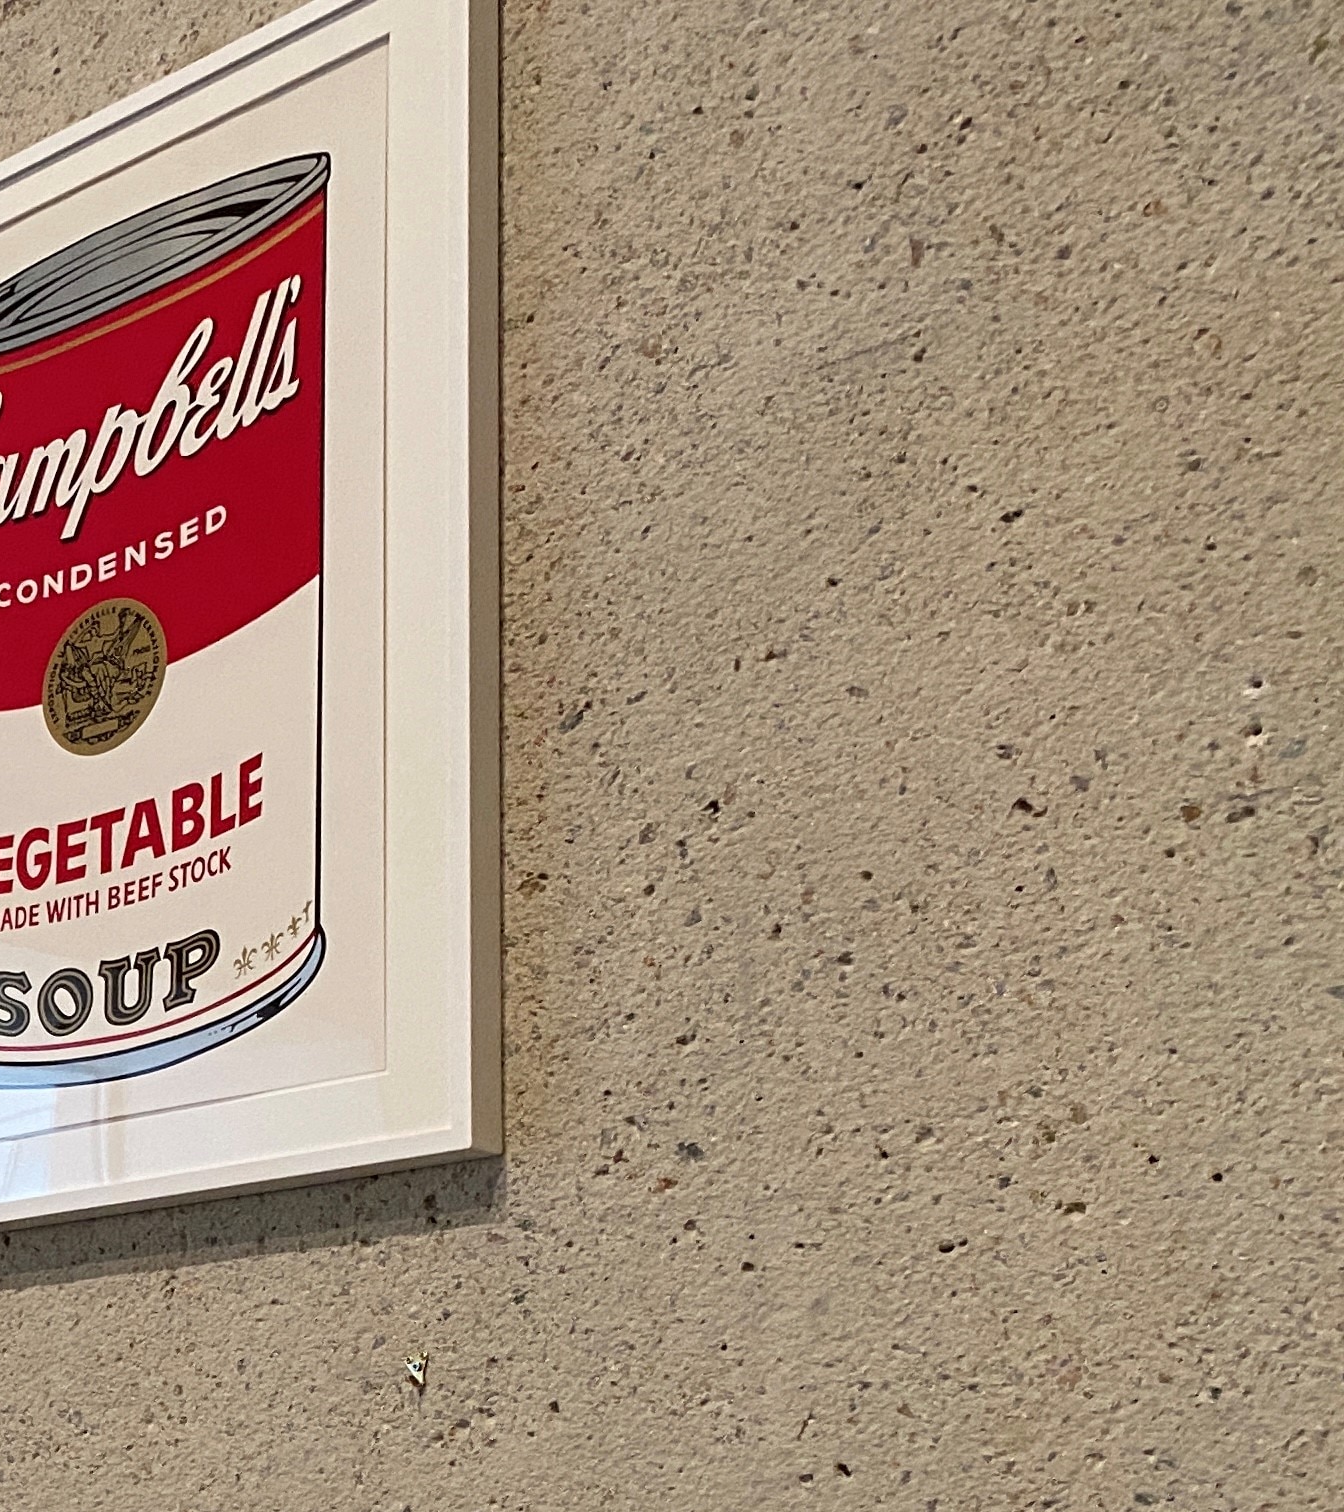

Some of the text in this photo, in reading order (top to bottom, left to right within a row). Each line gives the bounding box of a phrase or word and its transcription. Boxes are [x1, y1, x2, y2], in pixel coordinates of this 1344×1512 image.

[46, 889, 100, 924] WITH
[107, 872, 164, 911] BEEF
[168, 845, 232, 892] STOCK
